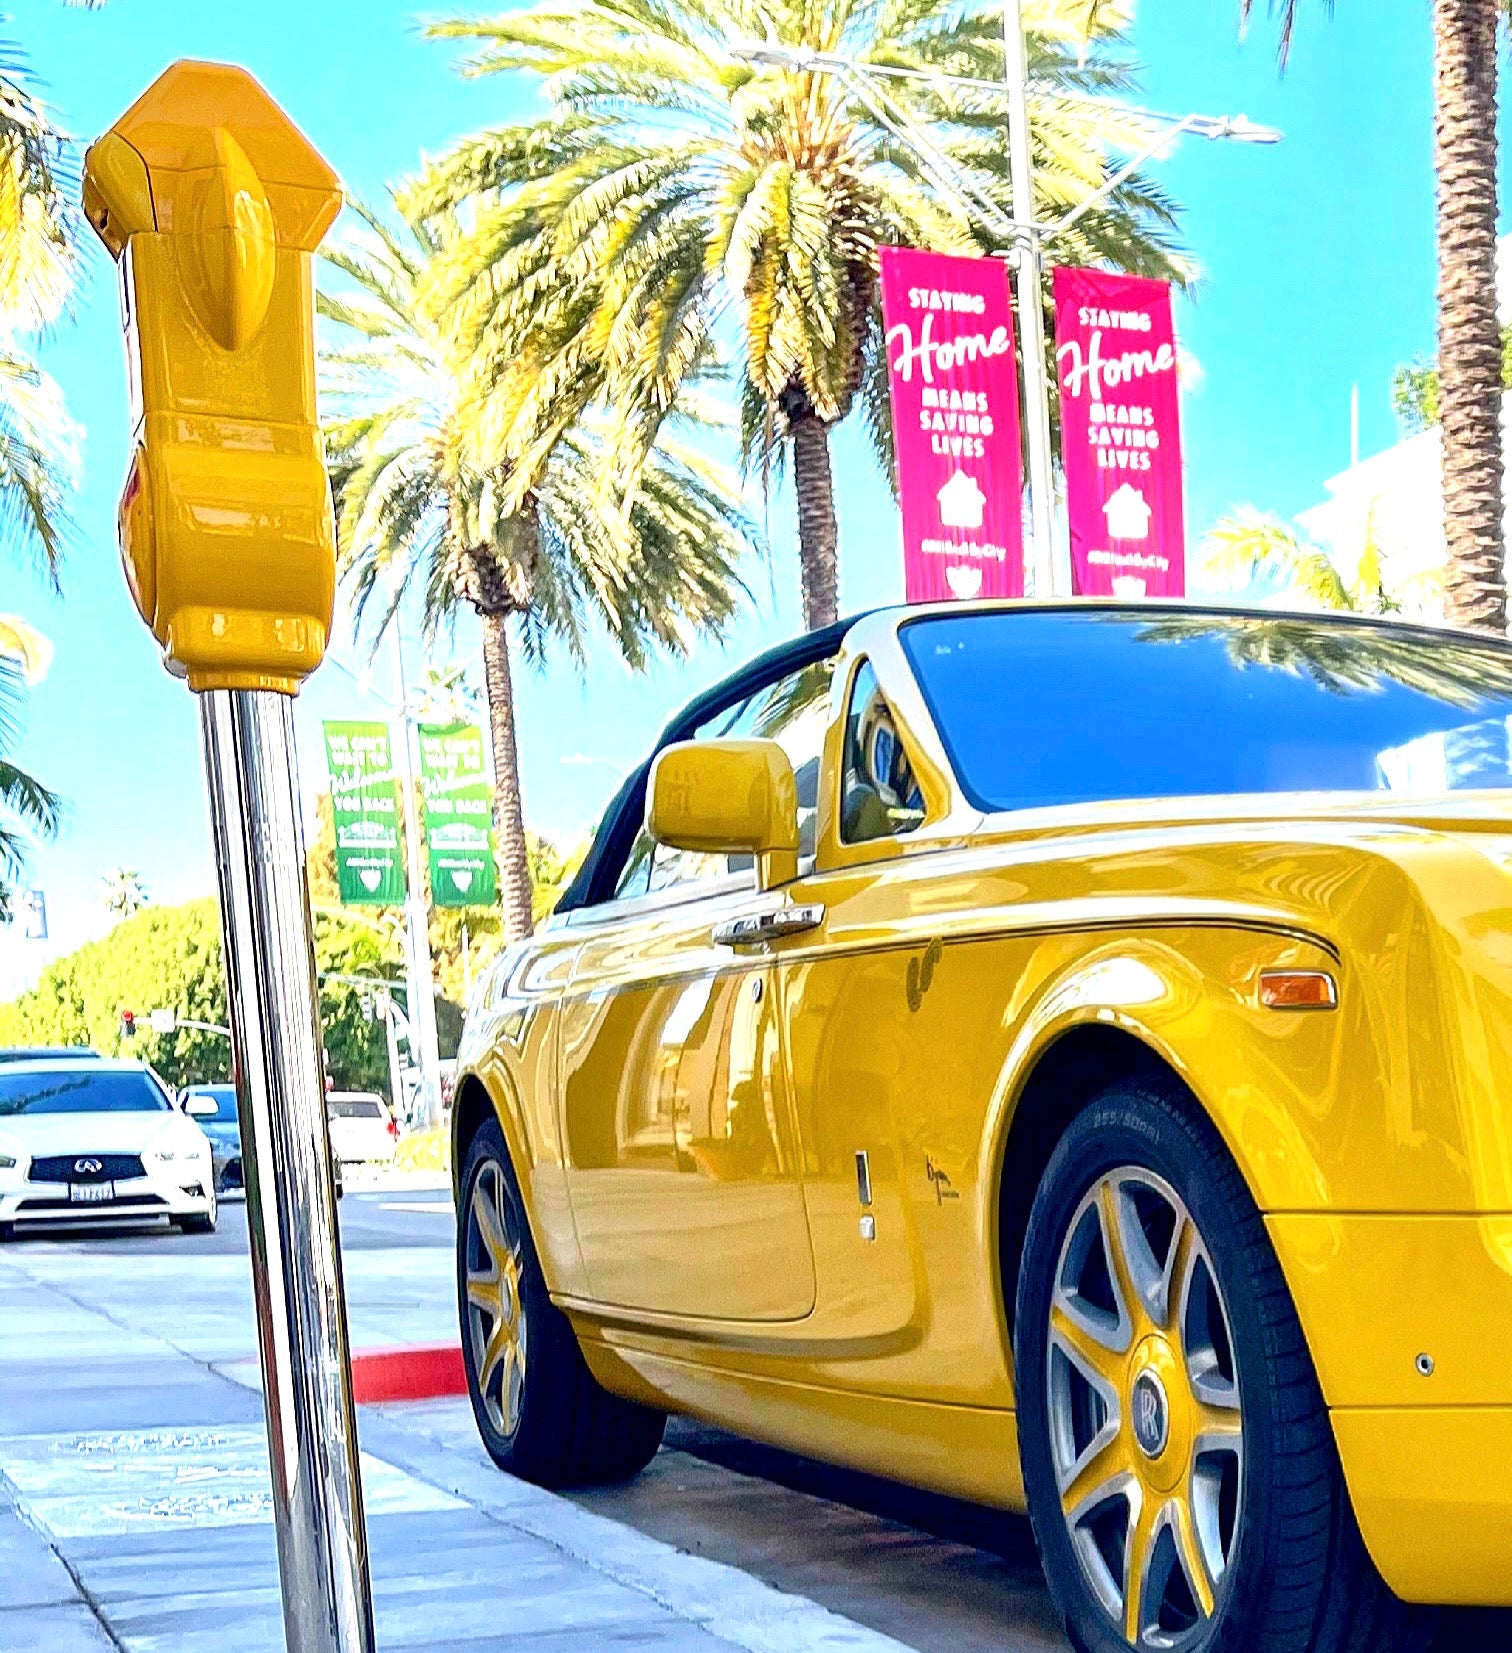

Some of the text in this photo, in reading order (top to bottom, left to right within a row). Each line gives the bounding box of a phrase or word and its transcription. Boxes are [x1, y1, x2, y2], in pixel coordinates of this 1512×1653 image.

[908, 288, 985, 314] STAYING
[1078, 307, 1151, 332] STAYING
[885, 314, 1010, 383] Home
[1056, 331, 1176, 399] Home
[922, 388, 988, 412] MEANS
[919, 410, 993, 436] SAVING
[1089, 403, 1153, 425] MEANS
[932, 435, 984, 458] LIVES
[1088, 427, 1159, 449] SAVING
[1097, 449, 1151, 470] LIVES
